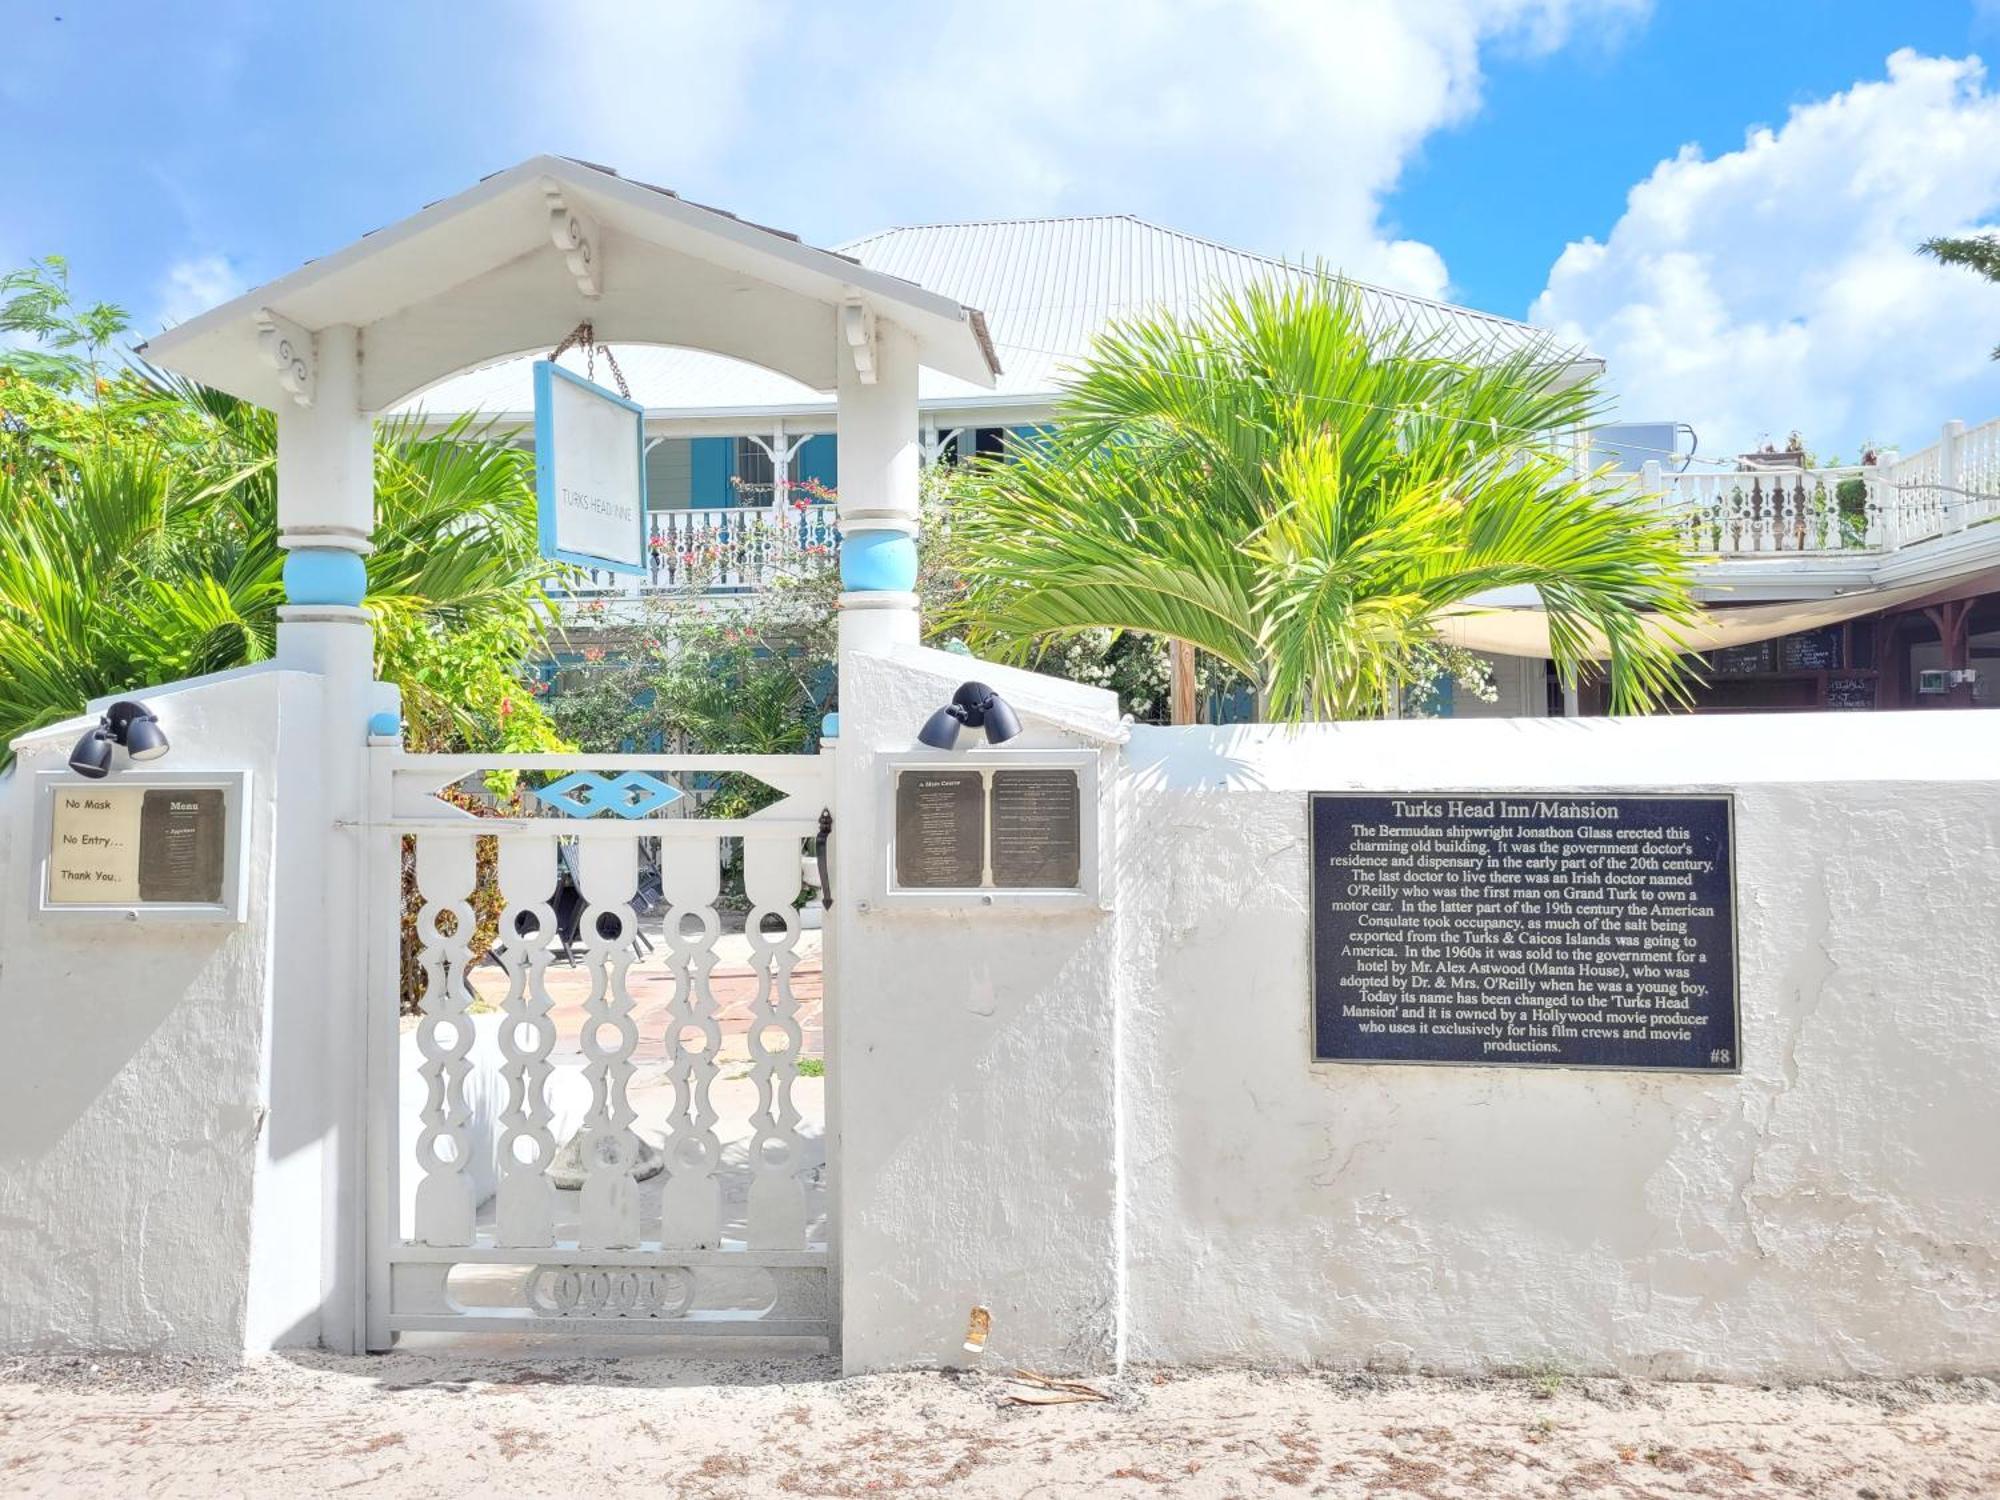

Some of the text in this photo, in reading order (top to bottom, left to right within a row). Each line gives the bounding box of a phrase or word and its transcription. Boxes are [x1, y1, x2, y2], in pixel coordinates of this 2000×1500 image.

[561, 488, 589, 510] TURKS
[590, 495, 612, 516] HEAD
[65, 799, 112, 810] No Mask
[170, 801, 199, 810] Menu
[1392, 800, 1442, 817] Turks
[1448, 800, 1494, 817] Head
[63, 834, 78, 844] No
[1352, 824, 1688, 840] The Bermudan shipwright Jonathon Glass erected this
[1349, 839, 1692, 856] charming old building. It was the government doctor's
[1330, 854, 1713, 872] residence and dispensary in the early part of the 20th century.
[60, 870, 91, 881] Thank
[1353, 870, 1375, 880] The
[1378, 870, 1400, 881] last
[1403, 870, 1443, 881] doctor
[1446, 872, 1459, 881] to
[1462, 871, 1486, 882] live
[1489, 871, 1521, 882] there
[1552, 875, 1567, 883] an
[1572, 872, 1600, 883] Irish
[1604, 872, 1646, 884] doctor
[1649, 873, 1692, 884] named
[1347, 884, 1697, 900] O'Reilly who was the first man on Grand Turk to own a
[1332, 900, 1713, 917] motor car. In the latter part of the 19th century the American
[1357, 914, 1420, 926] Consulate
[1422, 915, 1451, 927] took
[1527, 920, 1542, 928] as
[1544, 917, 1580, 929] much
[1583, 918, 1599, 929] of
[1600, 918, 1621, 930] the
[1624, 918, 1647, 930] salt
[1650, 919, 1687, 934] being
[1349, 929, 1696, 949] exported from the Turks & Caicos Islands was going to
[1341, 944, 1706, 964] America. In the 1960s it was sold to the government for a
[1356, 960, 1690, 977] hotel by Mr. Alex Astwood (Manta House), who was
[1339, 974, 1708, 996] adopted by Dr. & Mrs. O'Reilly when he was a young boy.
[1359, 990, 1689, 1008] Today its name has been changed to the 'Turks Head
[1342, 1005, 1708, 1027] Mansion' and it is owned by a Hollywood movie producer
[1358, 1020, 1691, 1039] who uses it exclusively for his film crews and movie
[1483, 1038, 1560, 1054] productions.
[1711, 1049, 1730, 1062] #8
